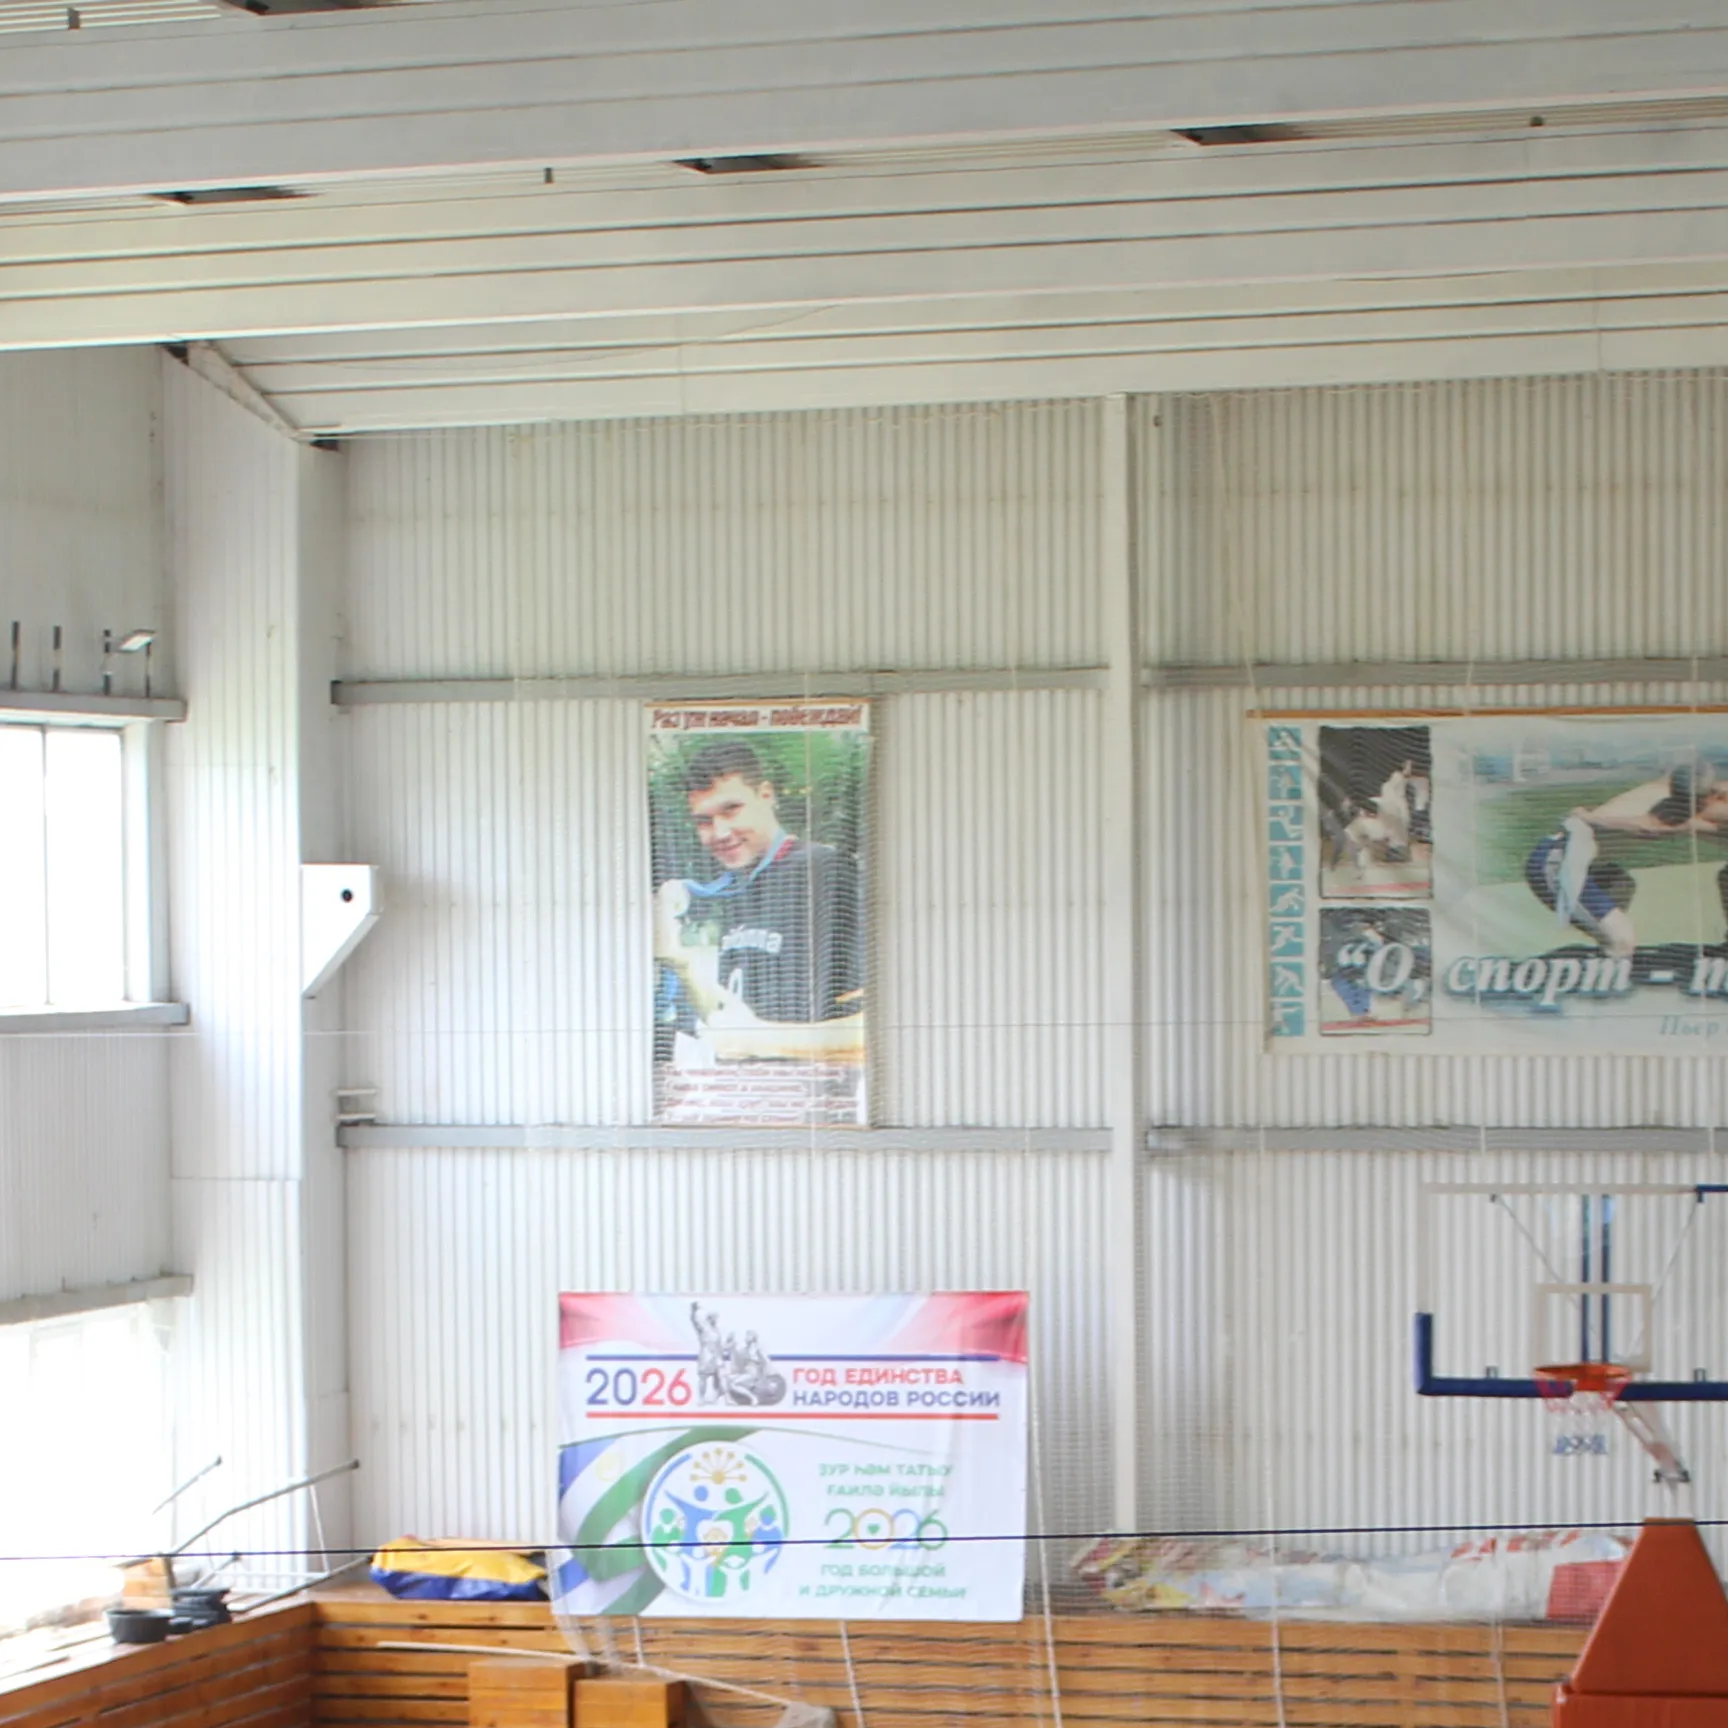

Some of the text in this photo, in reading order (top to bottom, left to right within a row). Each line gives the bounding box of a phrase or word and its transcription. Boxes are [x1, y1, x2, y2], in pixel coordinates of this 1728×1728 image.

[1447, 956, 1634, 1006] спорт
[792, 1367, 965, 1387] ГОД ЕДИНСТВА
[585, 1367, 693, 1407] 2026
[792, 1390, 1000, 1409] НАРОДОВ РОССИИ
[819, 1463, 850, 1476] ЗУР
[825, 1508, 948, 1551] 2026
[821, 1562, 946, 1577] ГОД БОЛЬШОЙ
[799, 1582, 967, 1598] И ДРУЖНОЙ СЕМЬИ
